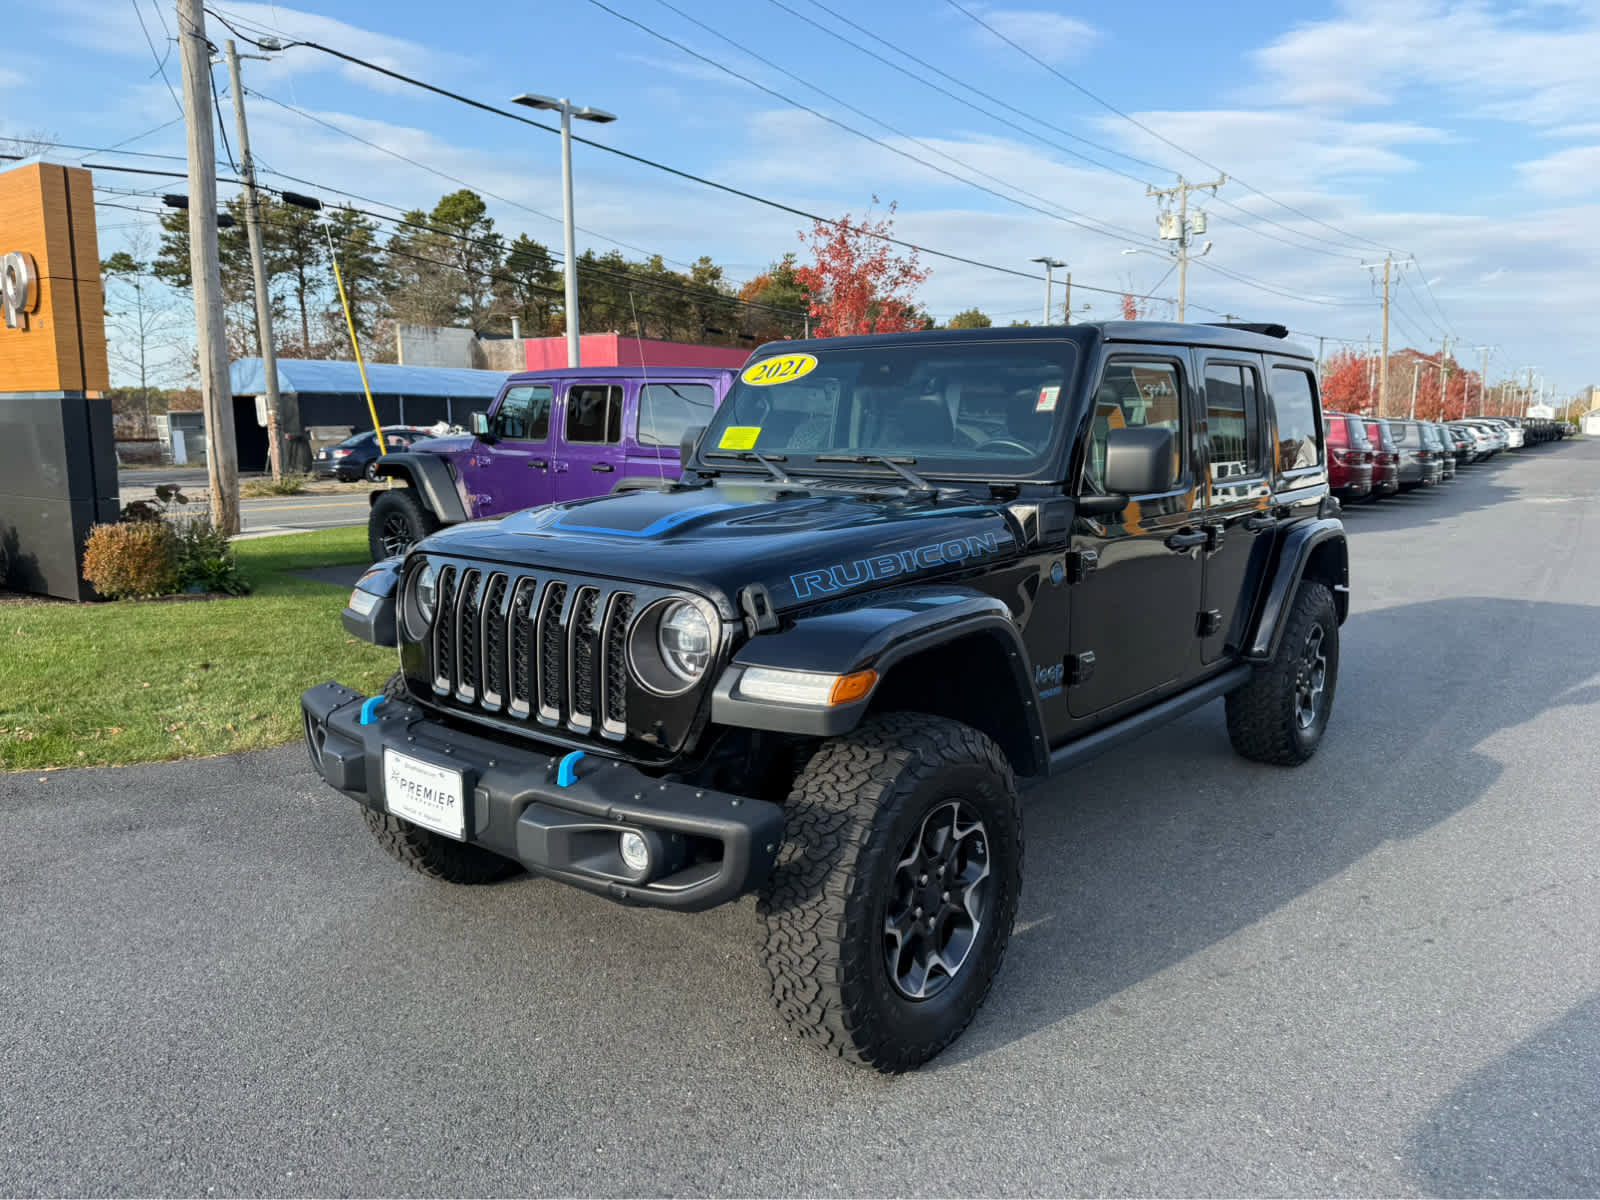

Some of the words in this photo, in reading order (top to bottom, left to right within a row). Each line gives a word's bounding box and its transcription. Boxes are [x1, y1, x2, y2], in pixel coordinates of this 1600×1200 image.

[752, 358, 806, 381] 2021
[790, 533, 999, 599] RUBICON
[400, 778, 455, 808] PREMIER
